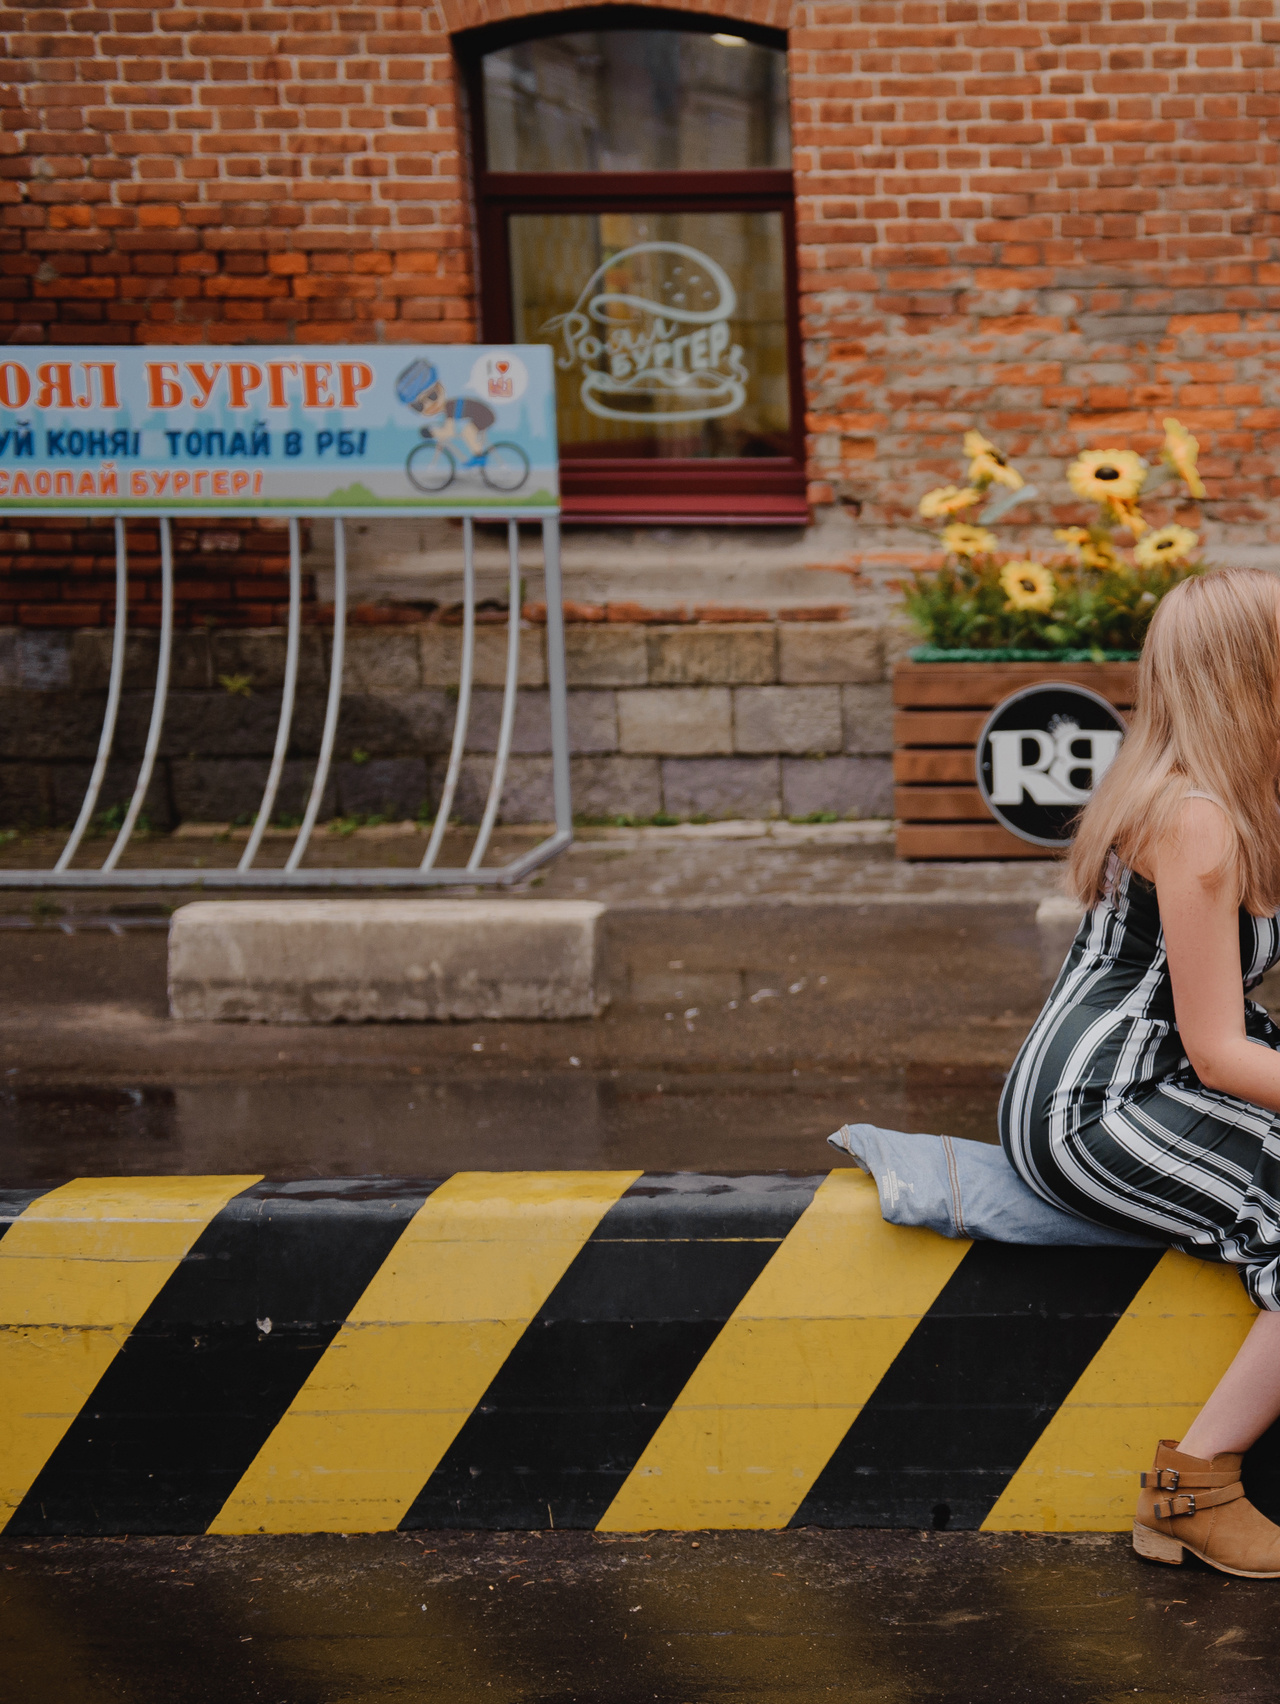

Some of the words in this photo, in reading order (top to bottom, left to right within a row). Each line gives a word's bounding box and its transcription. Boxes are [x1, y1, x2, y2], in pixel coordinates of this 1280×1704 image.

[144, 361, 374, 409] БУРГЕР
[165, 419, 270, 457] ТОПАЙ
[285, 430, 302, 457] В
[130, 470, 263, 496] БУРГЕР!
